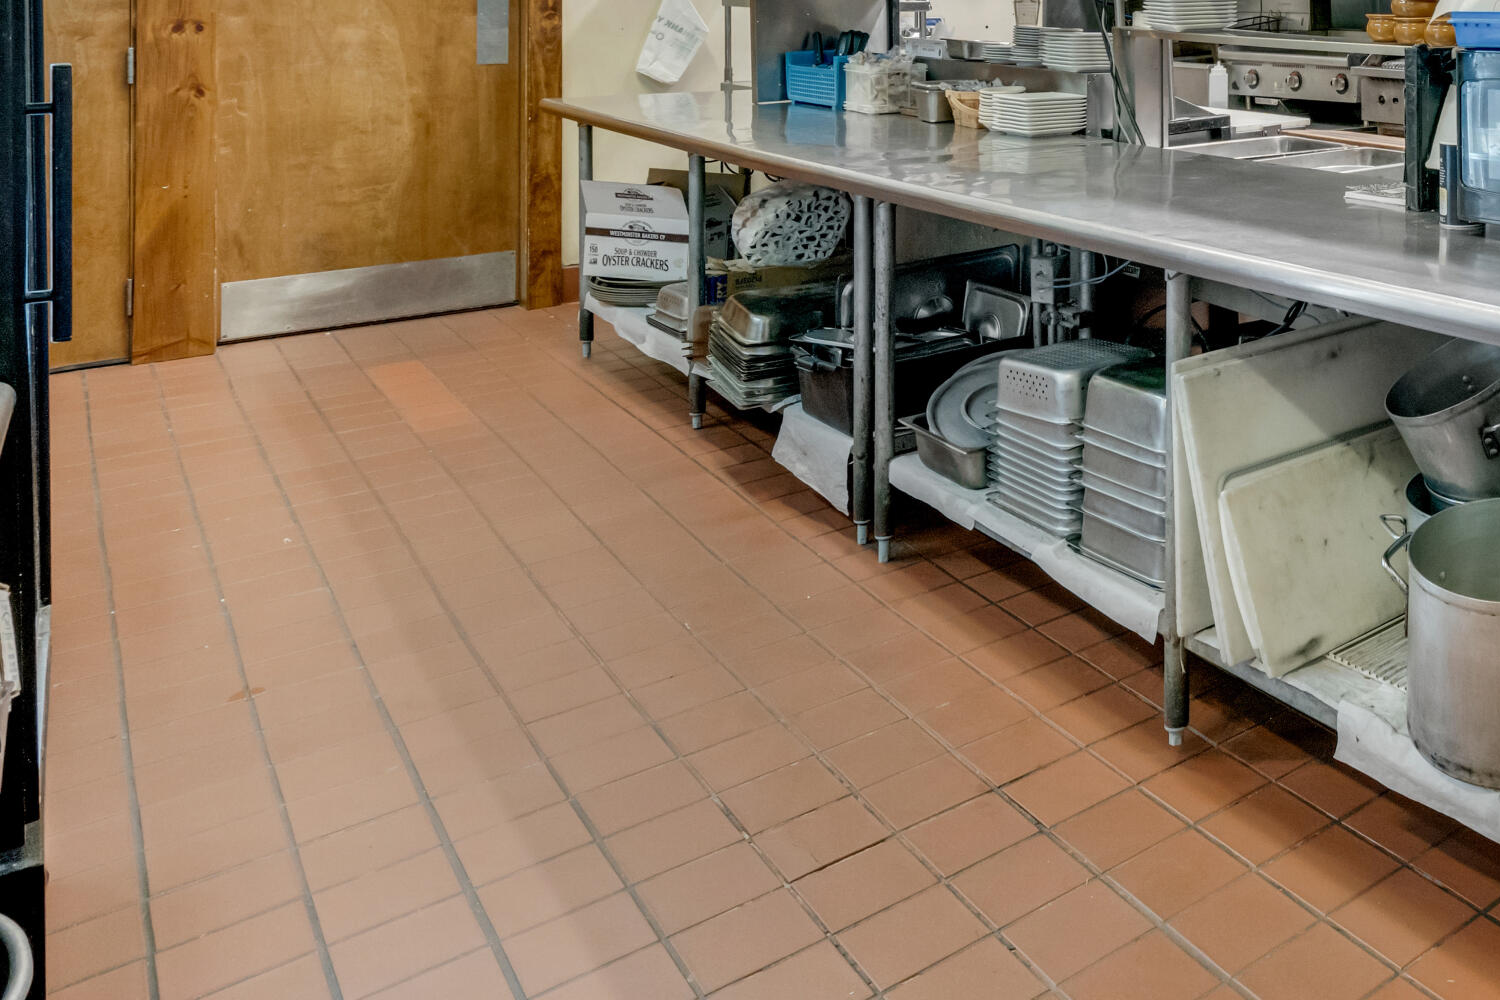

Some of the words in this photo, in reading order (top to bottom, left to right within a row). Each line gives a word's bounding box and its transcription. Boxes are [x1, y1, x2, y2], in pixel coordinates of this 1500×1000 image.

[614, 247, 628, 255] SOUP
[633, 249, 658, 258] CHOWDER
[602, 254, 630, 267] OYSTER
[631, 256, 669, 272] CRACKERS
